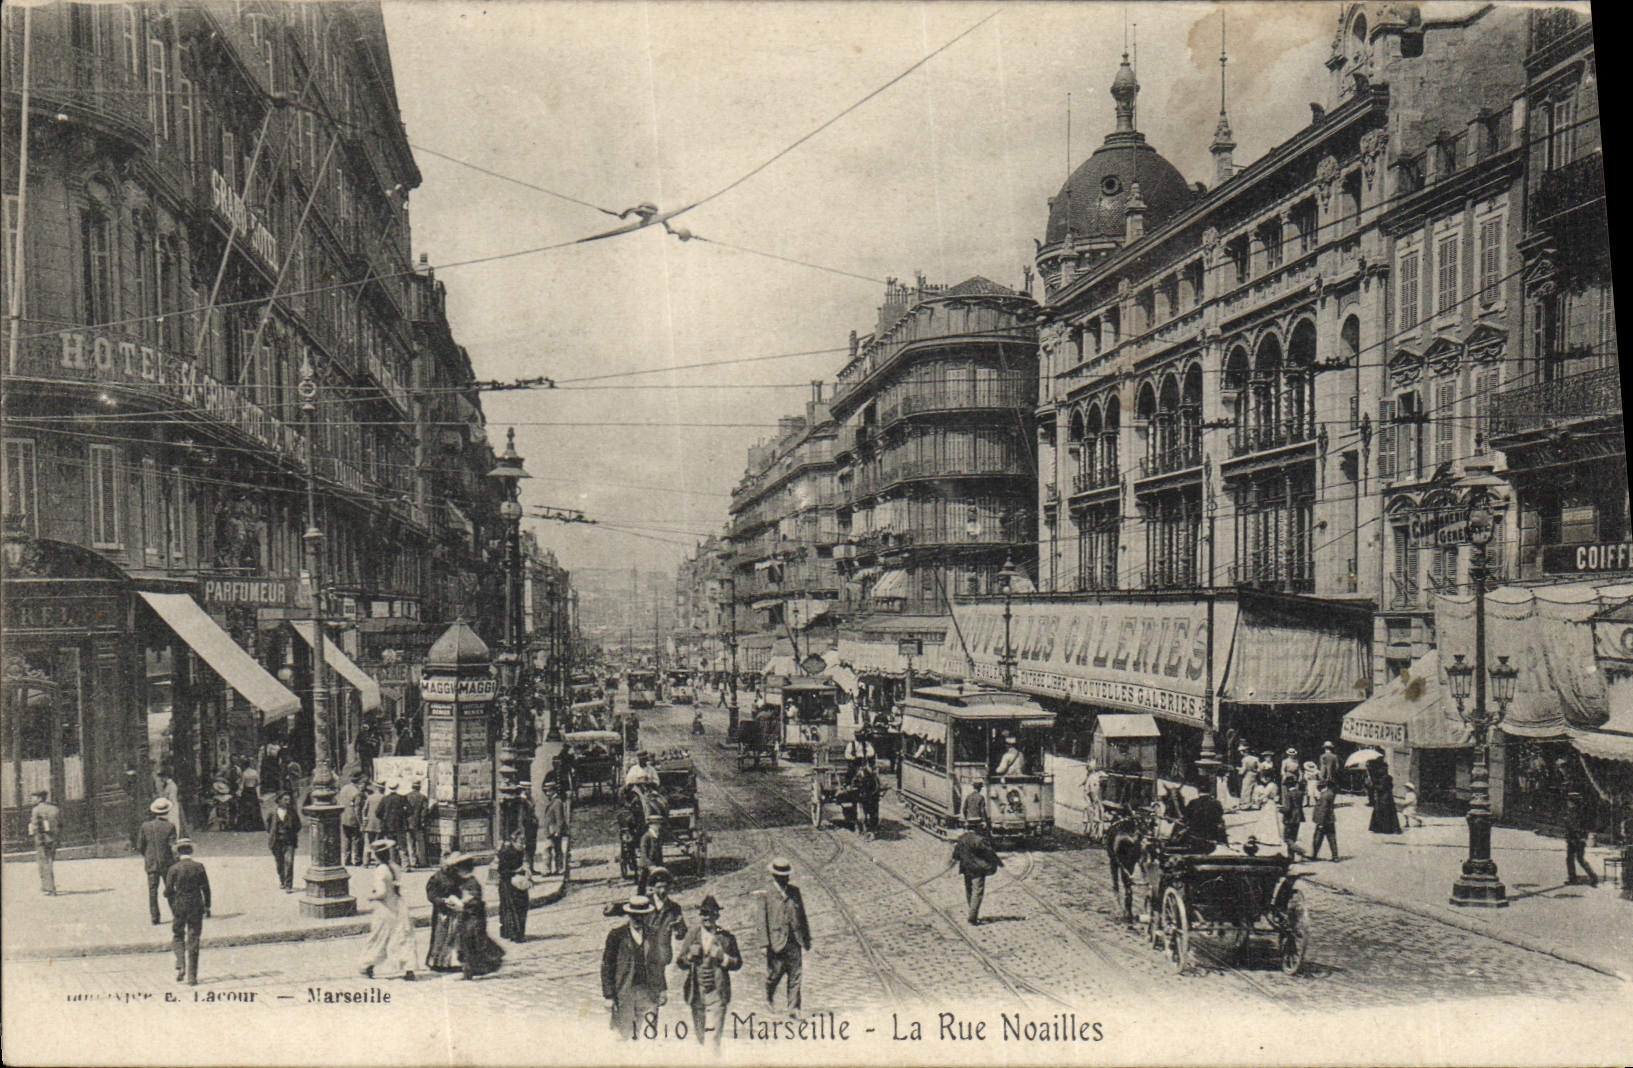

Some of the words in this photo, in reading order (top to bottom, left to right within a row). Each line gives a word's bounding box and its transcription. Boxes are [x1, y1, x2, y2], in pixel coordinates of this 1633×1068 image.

[59, 332, 166, 386] HOTEL
[205, 582, 286, 602] PARFUMEUR
[1064, 614, 1208, 682] GALERIES
[460, 682, 496, 695] MAGGI
[1077, 678, 1134, 704] NOUVELLES
[1138, 687, 1196, 716] GALERIES
